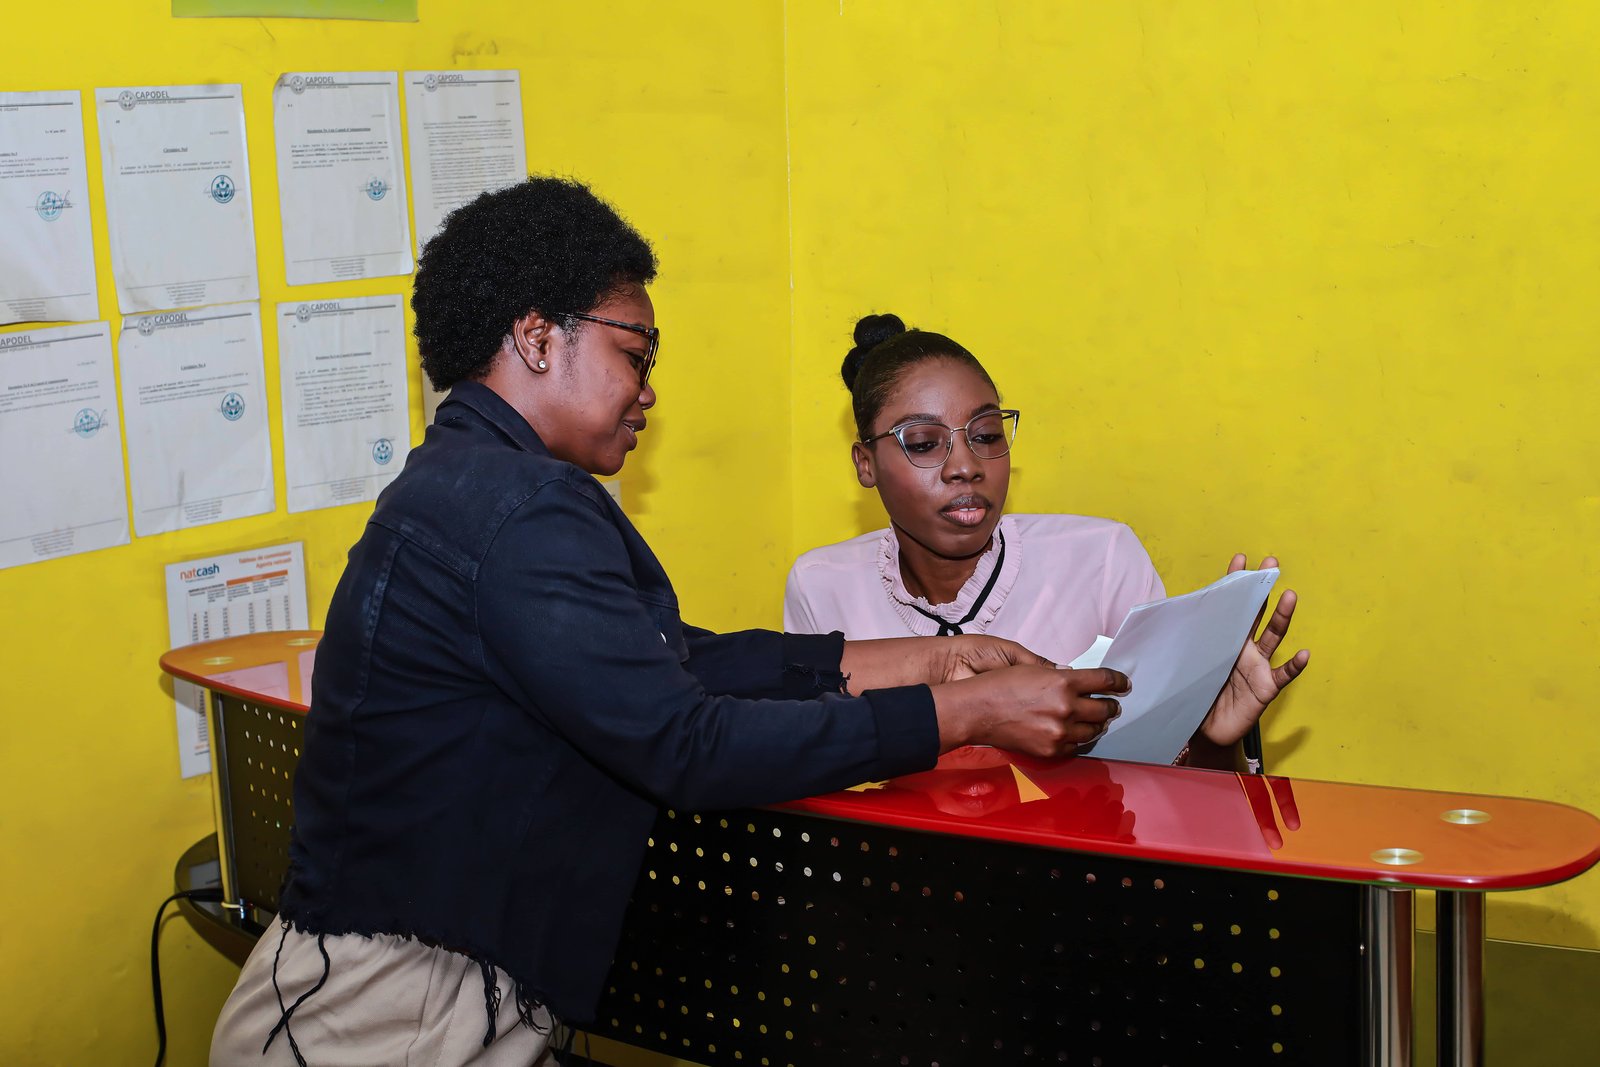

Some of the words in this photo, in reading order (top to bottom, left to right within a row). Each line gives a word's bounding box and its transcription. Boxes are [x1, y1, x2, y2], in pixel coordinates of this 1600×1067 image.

[305, 76, 335, 85] CAPODEL
[437, 74, 464, 82] CAPODEL
[135, 90, 170, 100] CAPODEL
[311, 302, 341, 312] CAPODEL
[154, 313, 188, 324] CAPODEL
[0, 335, 33, 347] APODEL
[180, 563, 220, 580] natcash
